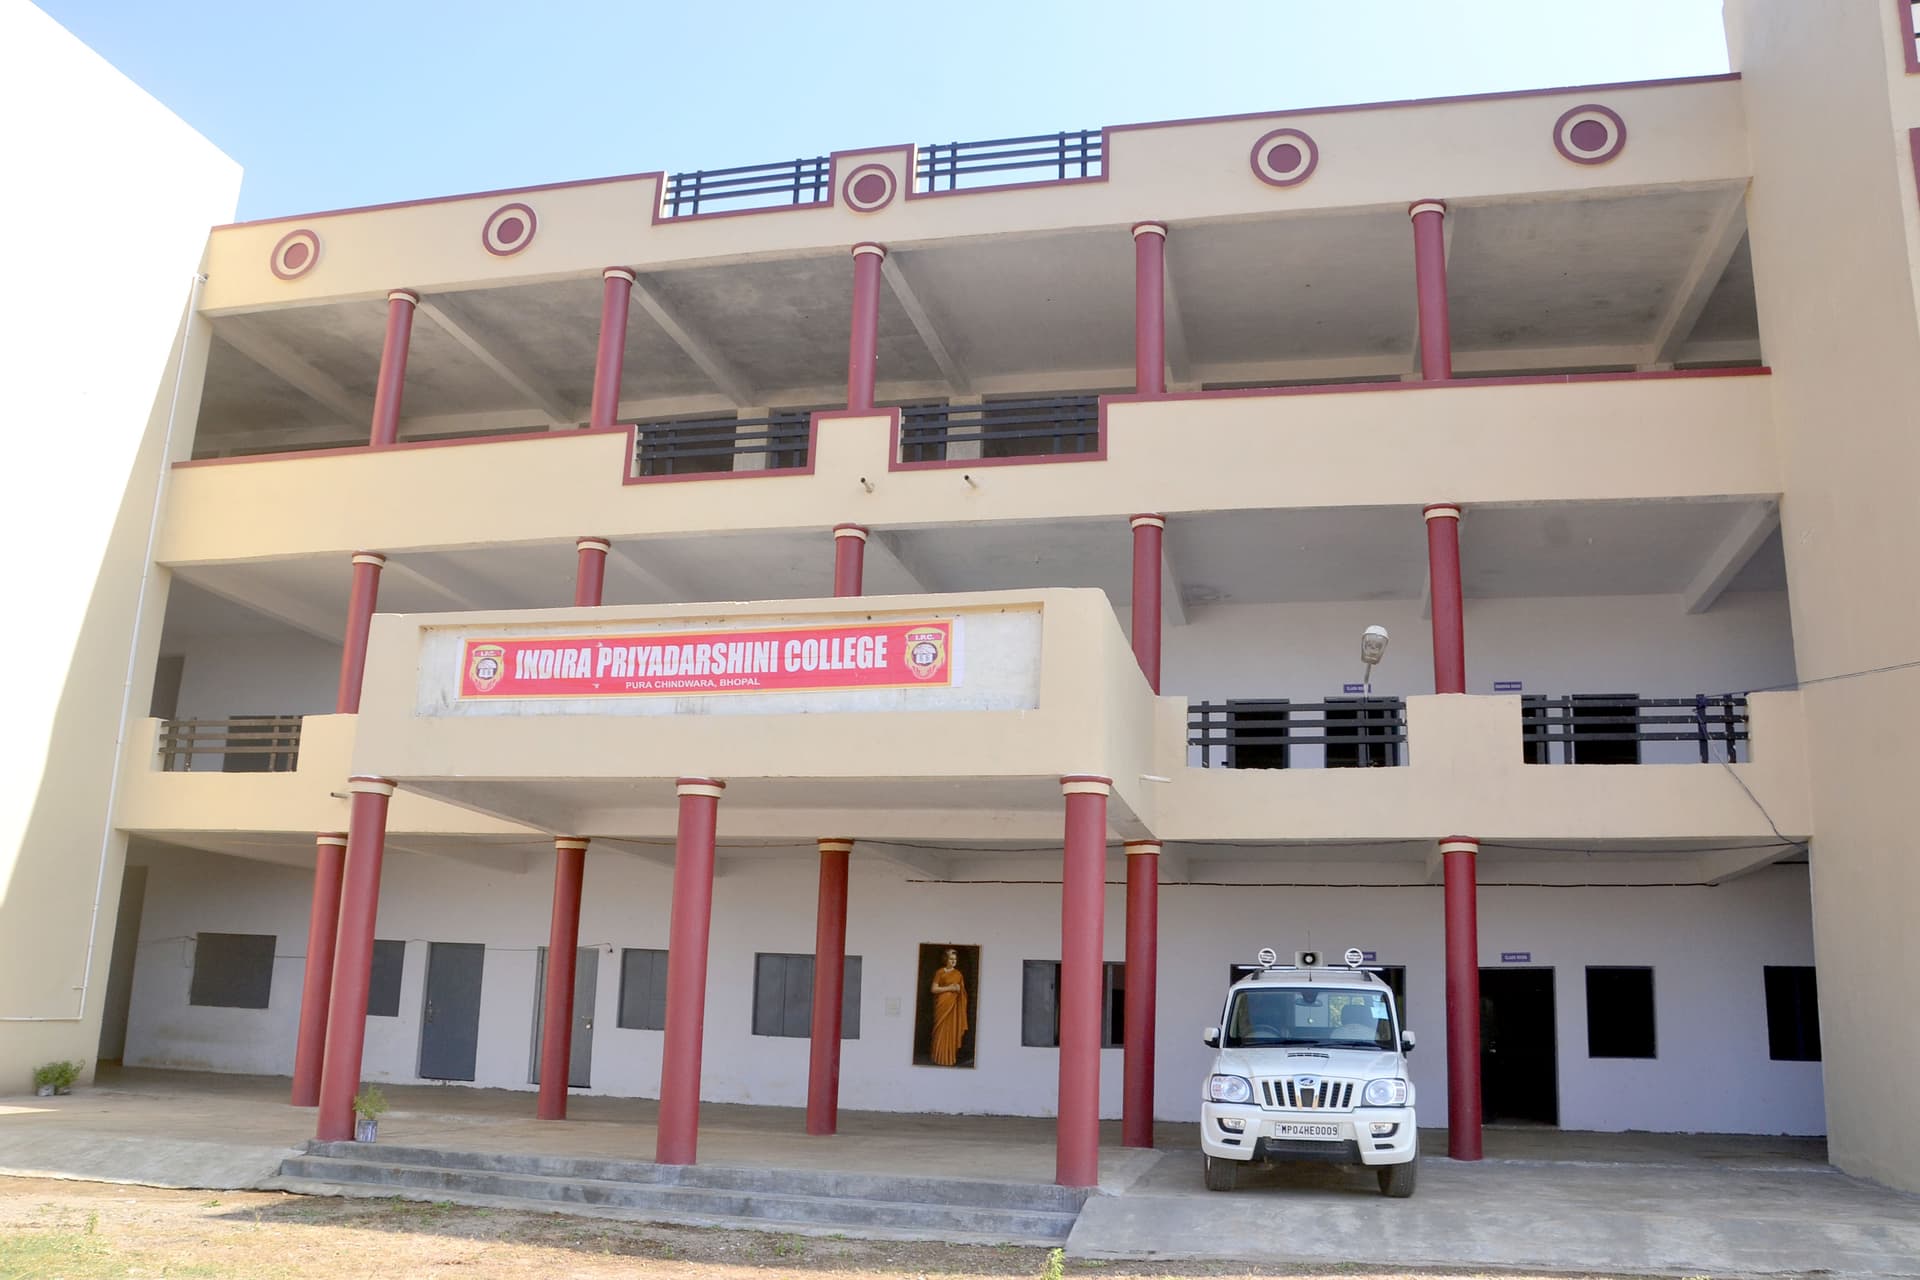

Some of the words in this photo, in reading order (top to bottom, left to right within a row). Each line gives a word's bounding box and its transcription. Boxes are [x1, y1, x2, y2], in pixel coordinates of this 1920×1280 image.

[515, 647, 592, 680] INDIRA
[596, 641, 778, 678] PRIYADARSHINI
[784, 635, 888, 672] COLLEGE
[625, 680, 652, 689] PURA
[654, 679, 717, 689] CHINDWARA,
[719, 677, 761, 687] BHOPAL
[1281, 1124, 1338, 1136] MP04HE0009
